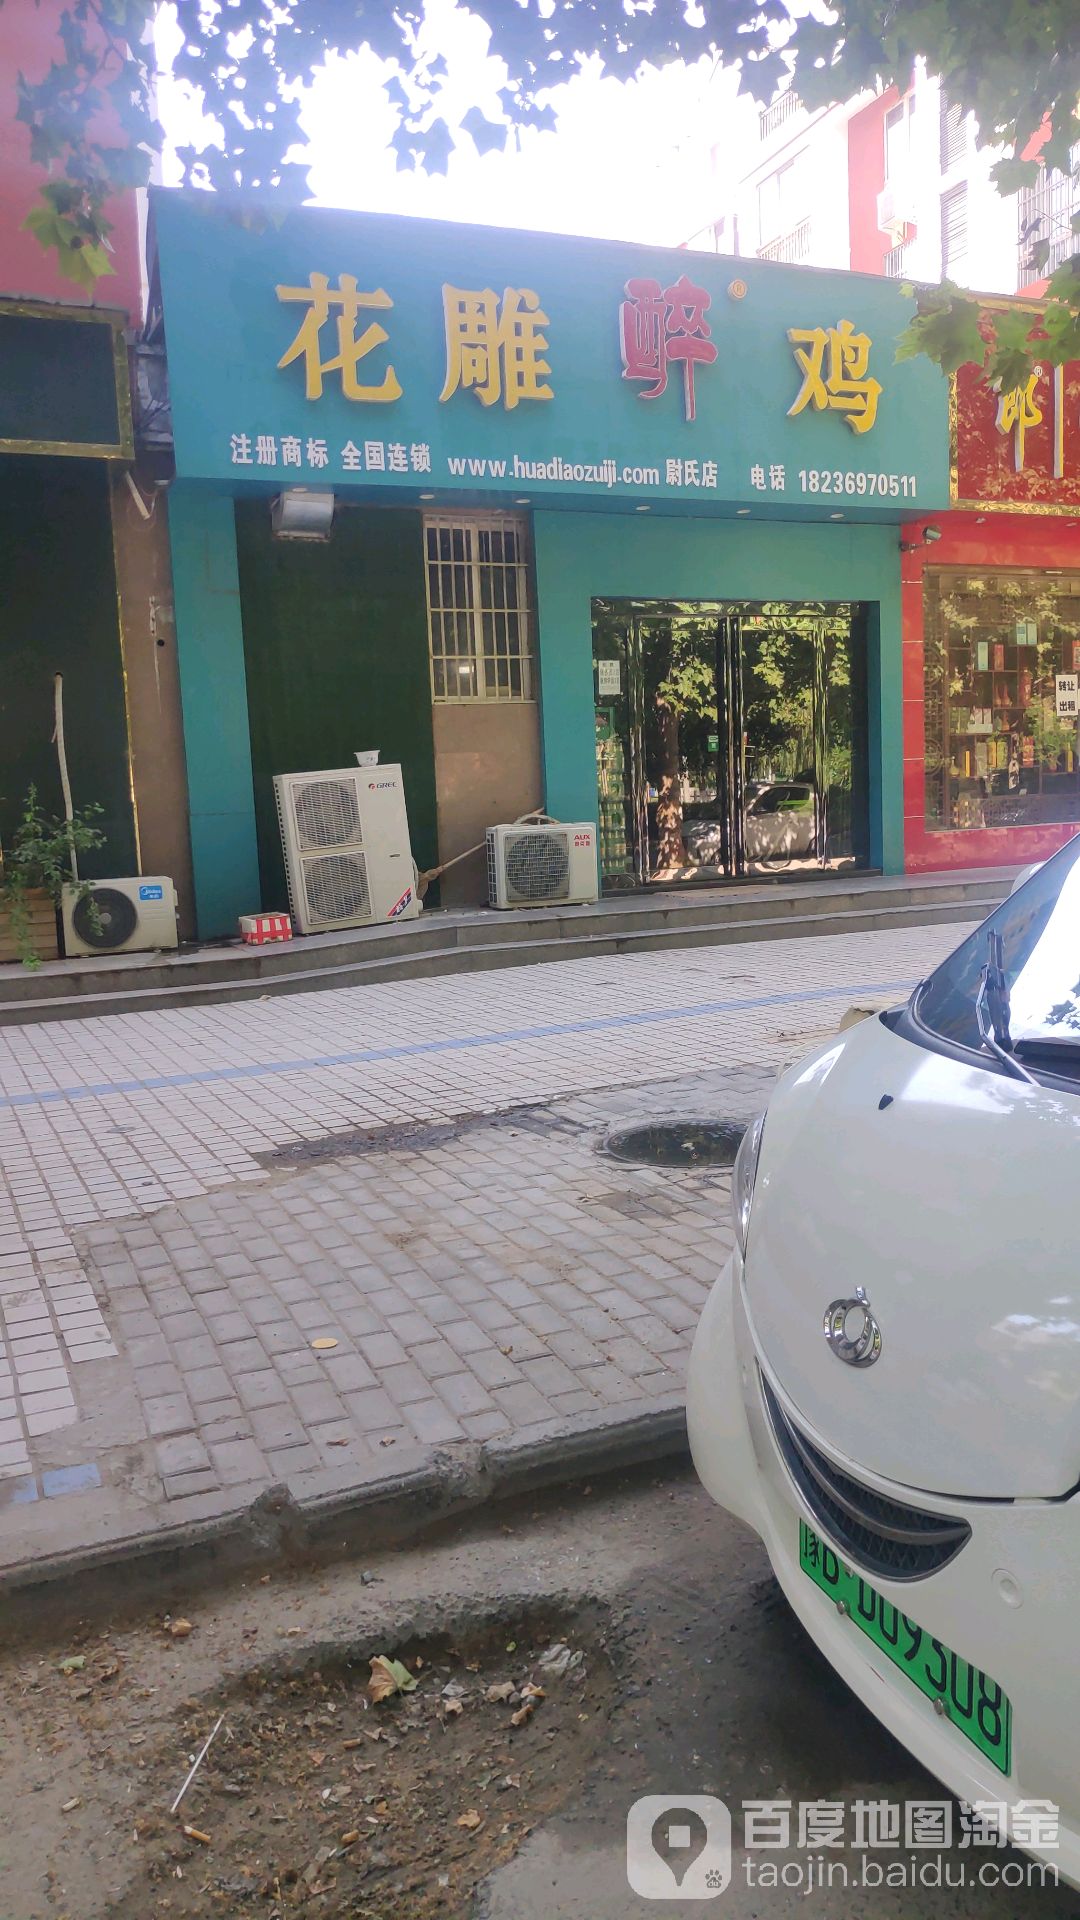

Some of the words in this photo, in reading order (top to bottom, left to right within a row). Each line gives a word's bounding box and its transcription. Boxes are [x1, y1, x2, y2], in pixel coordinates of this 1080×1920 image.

[275, 271, 884, 435] 花雕醉鸡
[230, 433, 329, 468] 注册商标
[340, 440, 432, 473] 全国连锁
[447, 454, 660, 488] www.huadiaozuiji.com
[665, 458, 718, 488] 尉氏店
[750, 463, 786, 491] 电话
[799, 470, 918, 497] 18236970511
[1058, 680, 1076, 692] 转让
[1059, 700, 1076, 712] 出租
